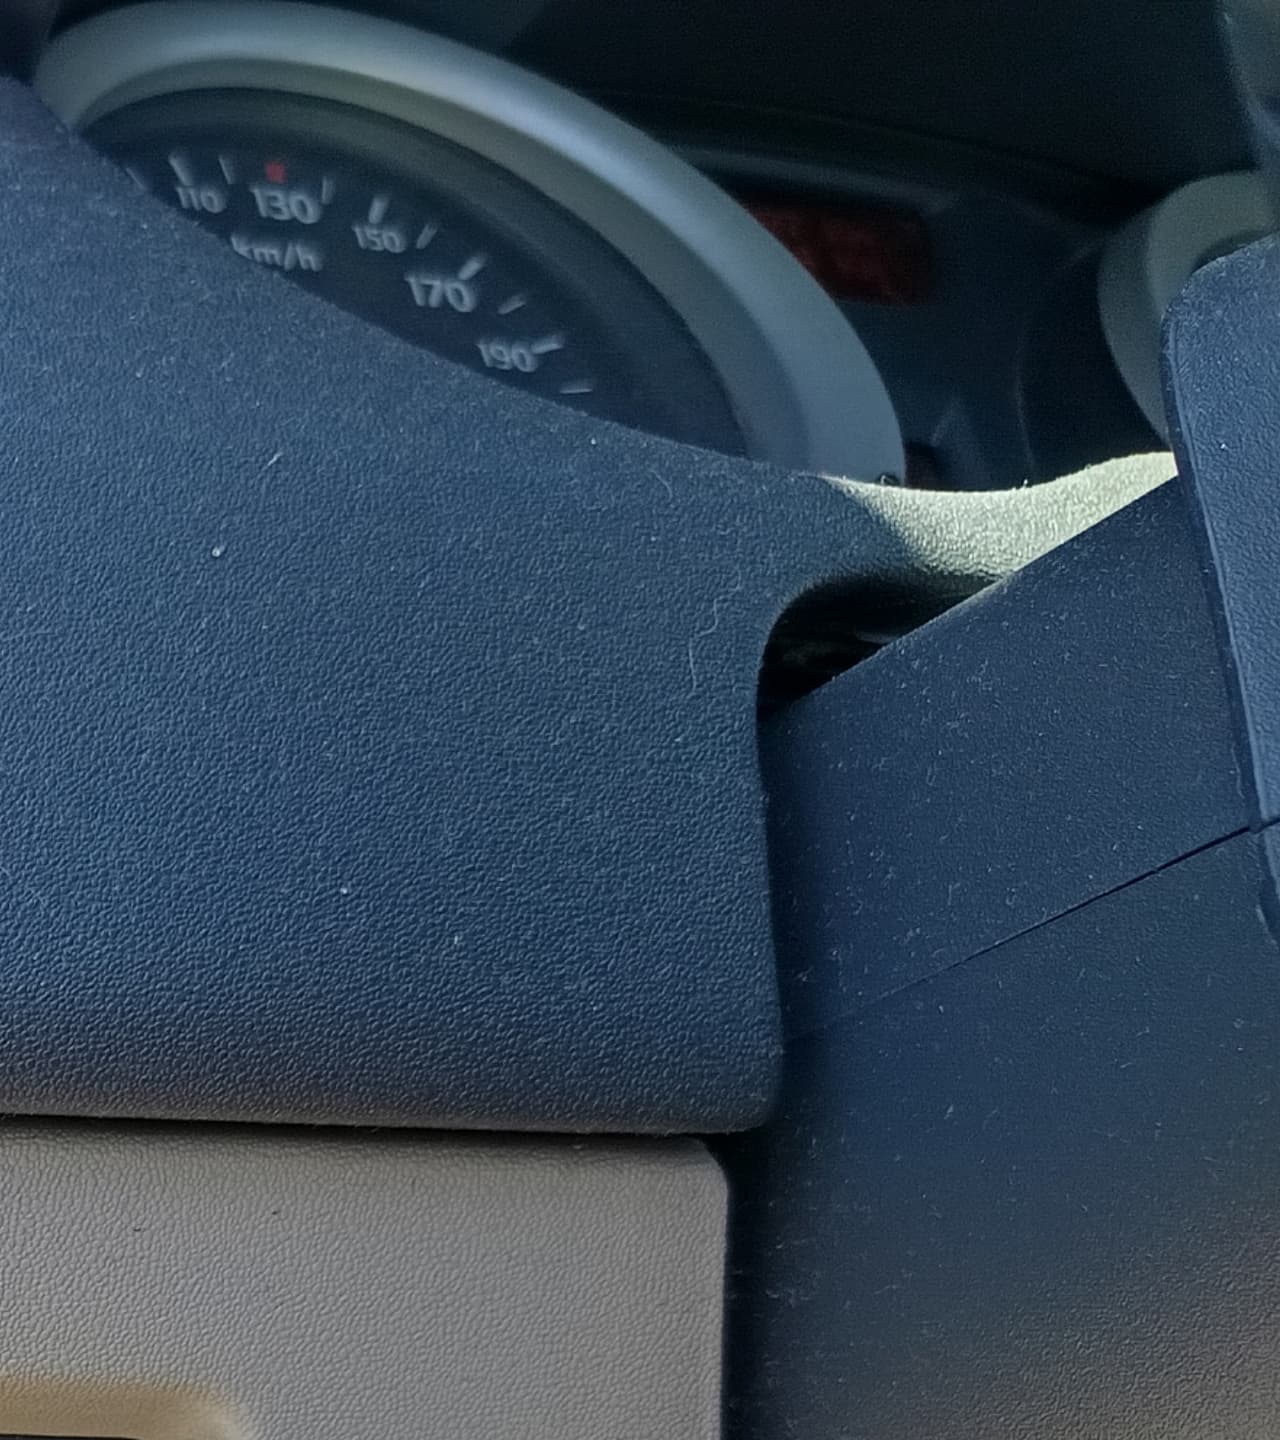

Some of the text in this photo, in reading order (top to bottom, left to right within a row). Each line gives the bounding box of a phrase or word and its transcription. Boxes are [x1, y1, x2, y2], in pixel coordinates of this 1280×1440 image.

[175, 183, 227, 215] 110
[250, 182, 324, 225] 130
[230, 232, 324, 273] km/h
[352, 222, 408, 255] 150
[404, 271, 478, 314] 170
[475, 339, 540, 374] 190
